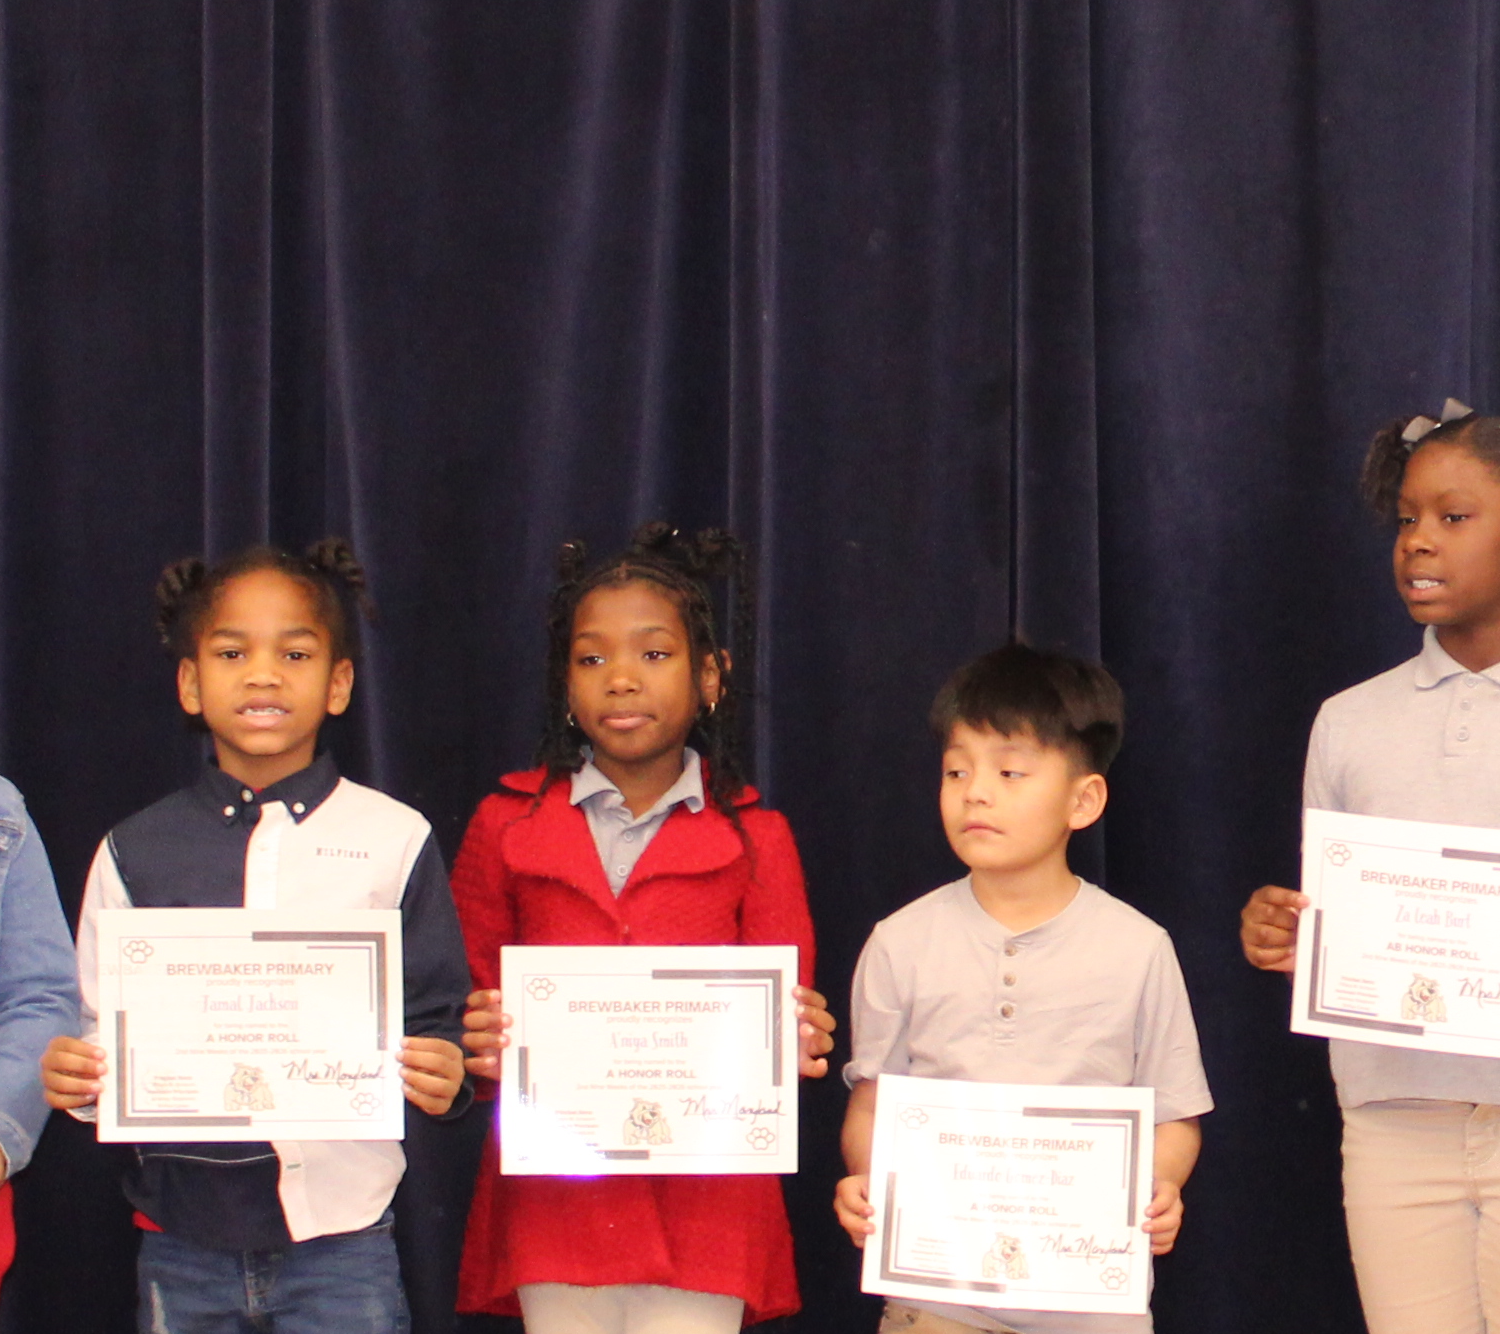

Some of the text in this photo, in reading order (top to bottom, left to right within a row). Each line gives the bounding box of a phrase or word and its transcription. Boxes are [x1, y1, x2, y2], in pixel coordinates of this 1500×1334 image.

[1361, 870, 1447, 891] BREWBAKER
[1387, 942, 1481, 961] AB HONOR ROLL
[167, 964, 334, 975] BREWBAKER PRIMARY
[202, 992, 299, 1013] Jamal Jackson
[569, 1002, 731, 1013] BREWBAKER PRIMARY
[206, 1034, 299, 1043] A HONOR ROLL
[652, 1031, 688, 1048] Smith
[606, 1070, 696, 1078] A HONOR ROLL
[939, 1133, 1095, 1152] BREWBAKER PRIMARY
[970, 1202, 1059, 1216] A HONOR ROLL
